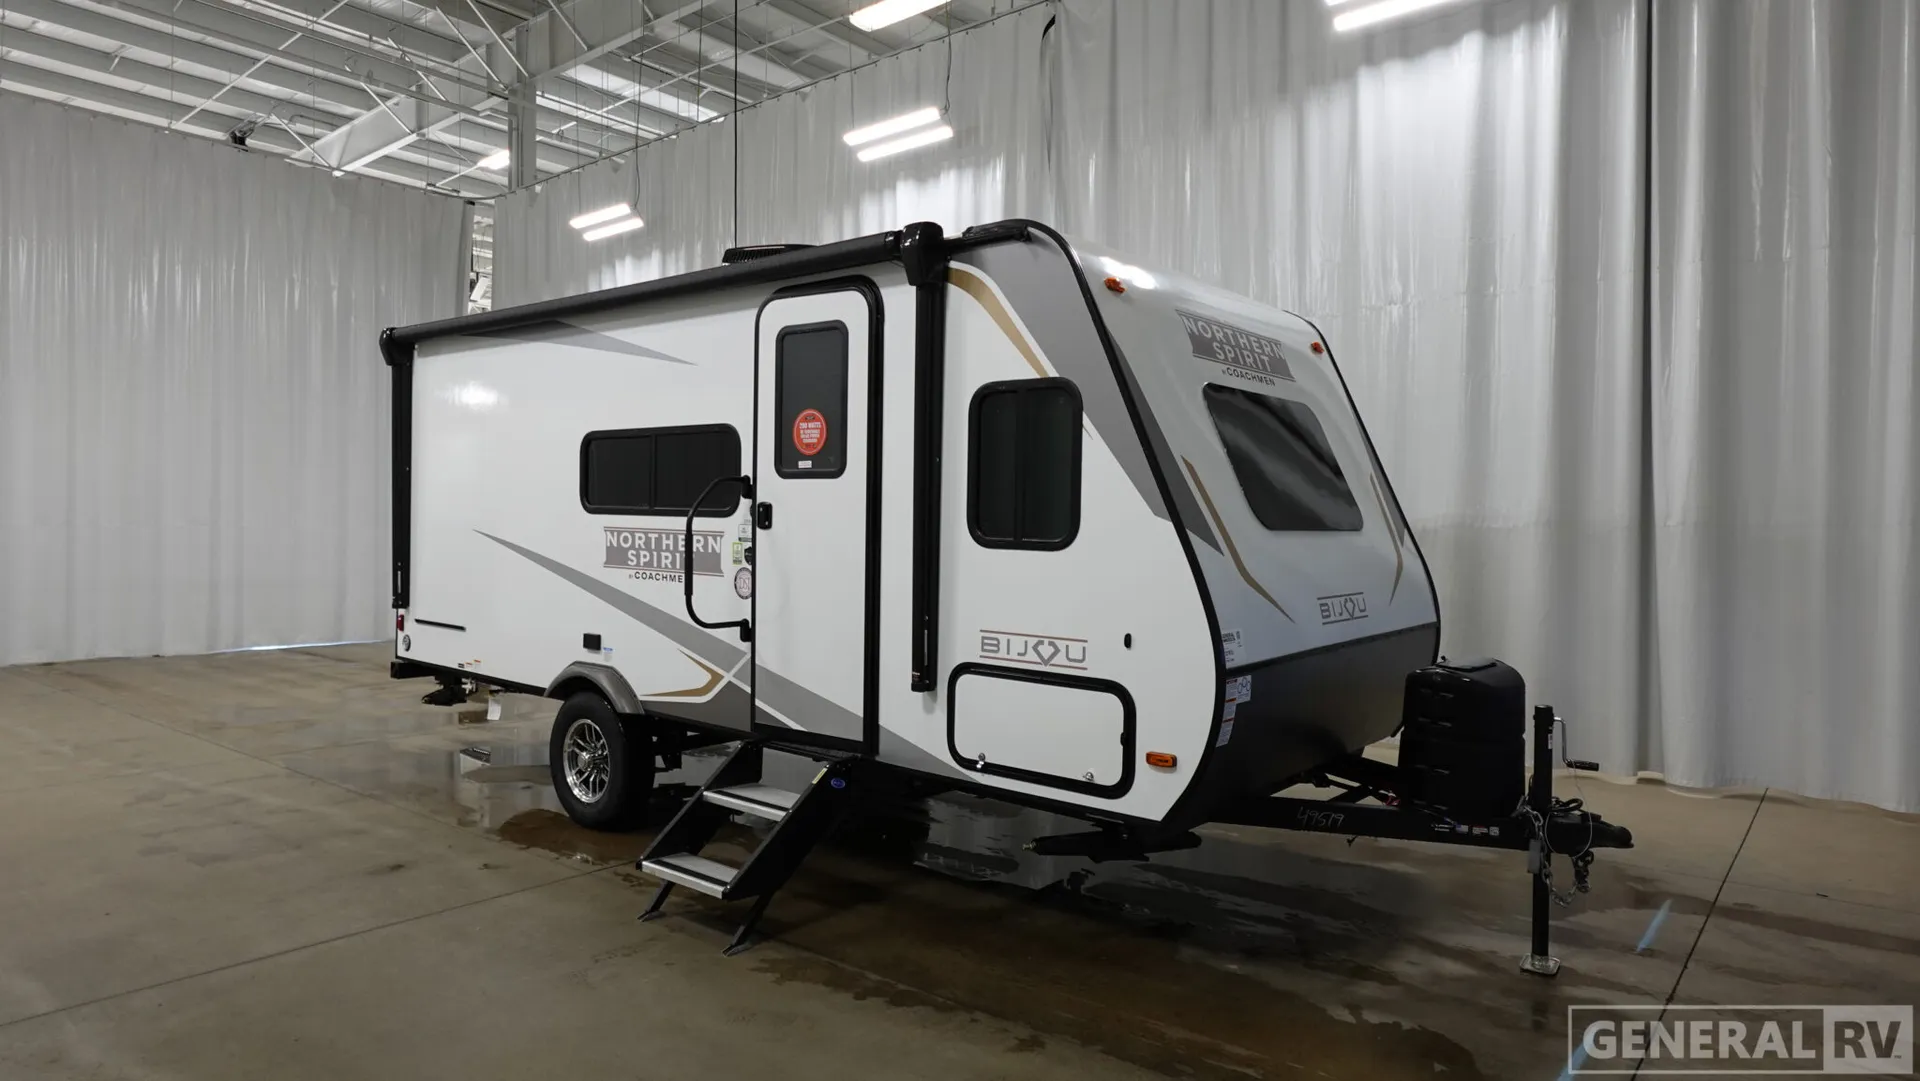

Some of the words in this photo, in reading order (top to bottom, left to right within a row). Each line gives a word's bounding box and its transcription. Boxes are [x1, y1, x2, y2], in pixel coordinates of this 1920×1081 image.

[1181, 315, 1285, 359] NORTHERN
[1212, 341, 1271, 371] SPIRIT
[1226, 367, 1276, 386] COACHMEN
[606, 531, 721, 553] NORTHERN
[627, 549, 695, 569] SPIRI
[634, 571, 690, 583] COACHME
[1319, 596, 1367, 620] BIJOU
[980, 635, 1087, 667] BIJOU
